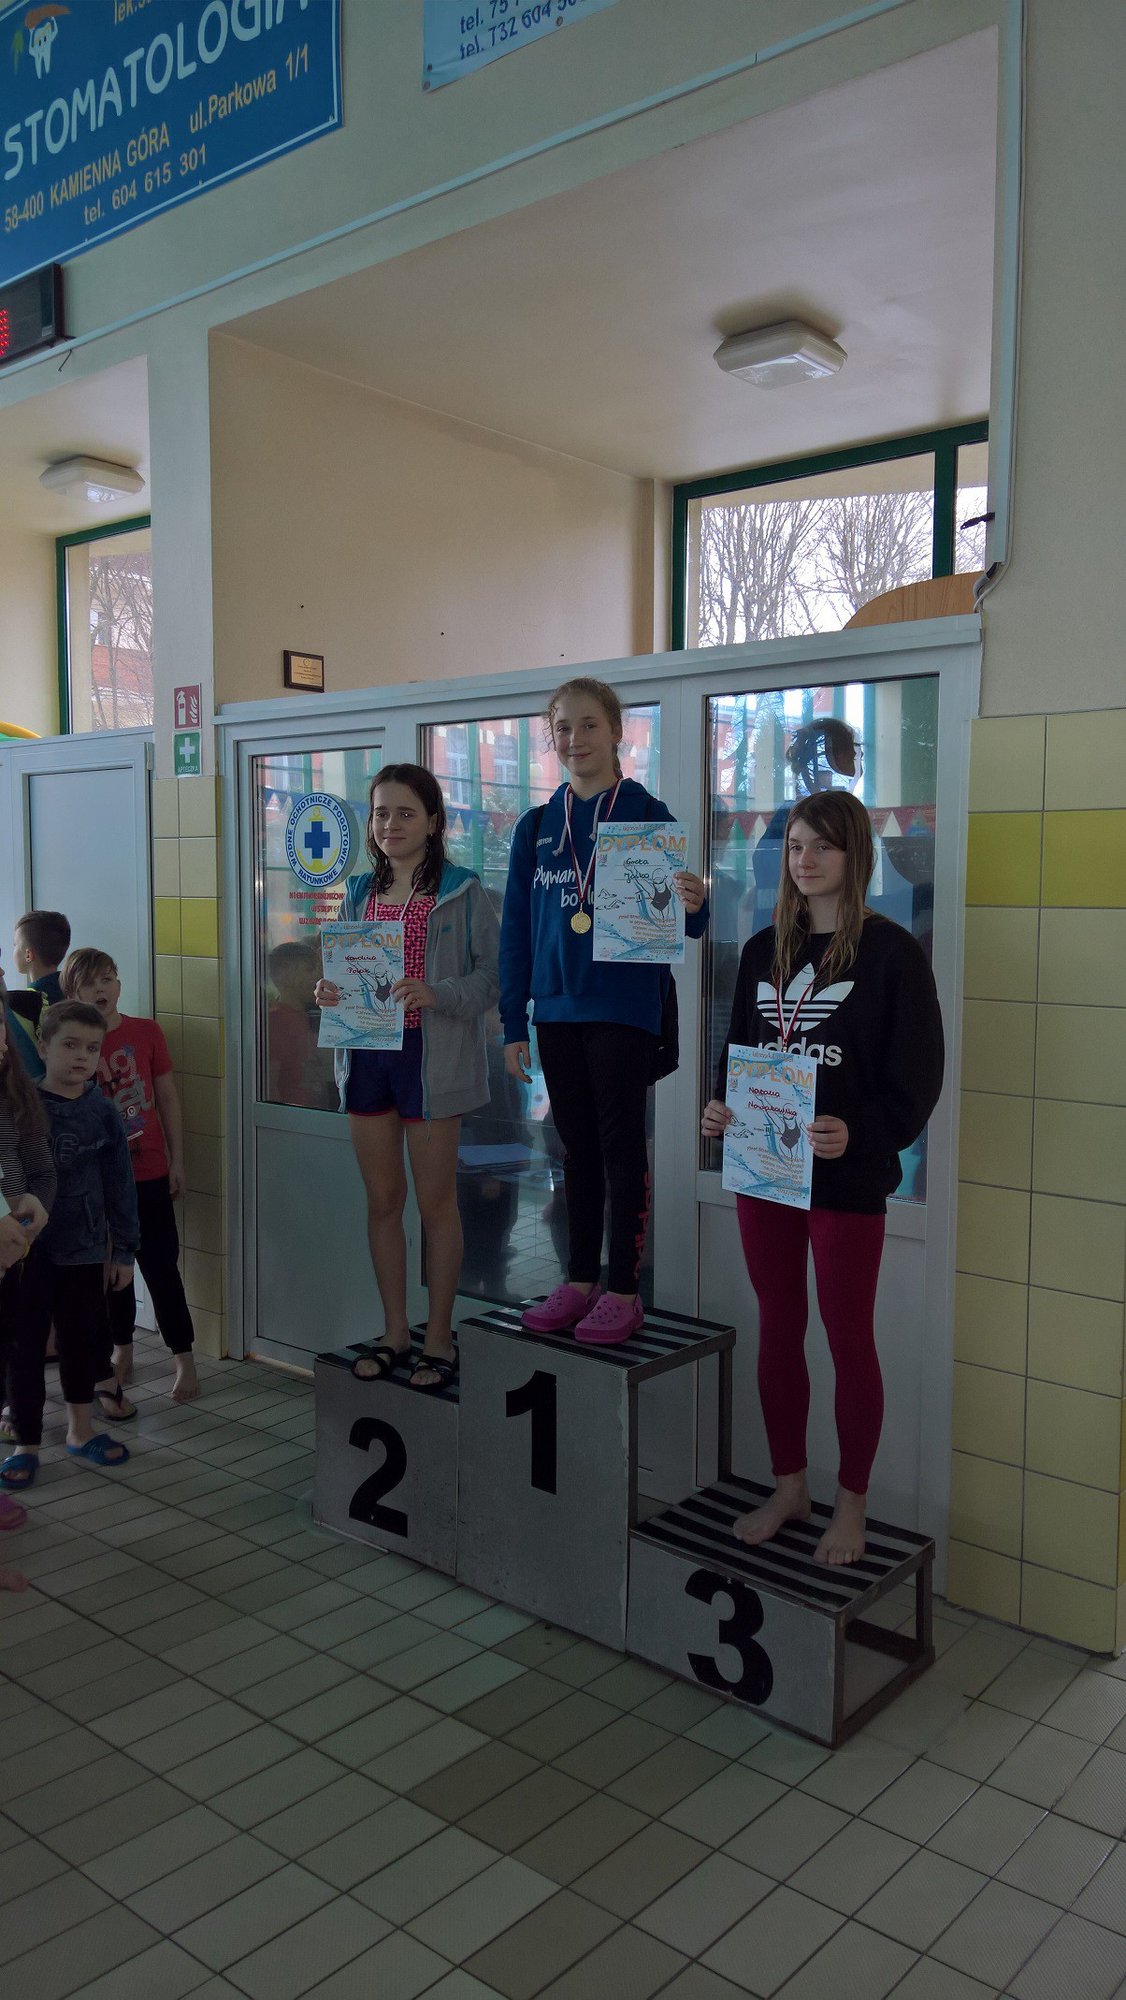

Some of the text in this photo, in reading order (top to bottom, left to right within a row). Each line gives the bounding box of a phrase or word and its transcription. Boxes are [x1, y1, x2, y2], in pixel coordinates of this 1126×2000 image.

[460, 8, 483, 34] tel.
[460, 36, 484, 60] tel.
[488, 17, 518, 47] 732
[521, 2, 551, 29] 604
[4, 191, 44, 232] 58-400
[50, 150, 121, 209] KAMIENNA
[126, 122, 170, 167] GÓRA
[285, 43, 309, 82] 1/1
[84, 144, 207, 226] tel. 604 615 301
[290, 795, 333, 826] OCHOTNICZE
[332, 802, 349, 866] POGOTOWIE
[287, 829, 299, 867] WODNE
[599, 834, 686, 852] DYPLOM
[298, 869, 338, 885] RATUNKOWE
[323, 933, 403, 949] DYPLOM
[729, 1058, 814, 1089] DYPLOM
[506, 1369, 557, 1495] 1
[348, 1417, 408, 1538] 2
[684, 1567, 774, 1706] 3
